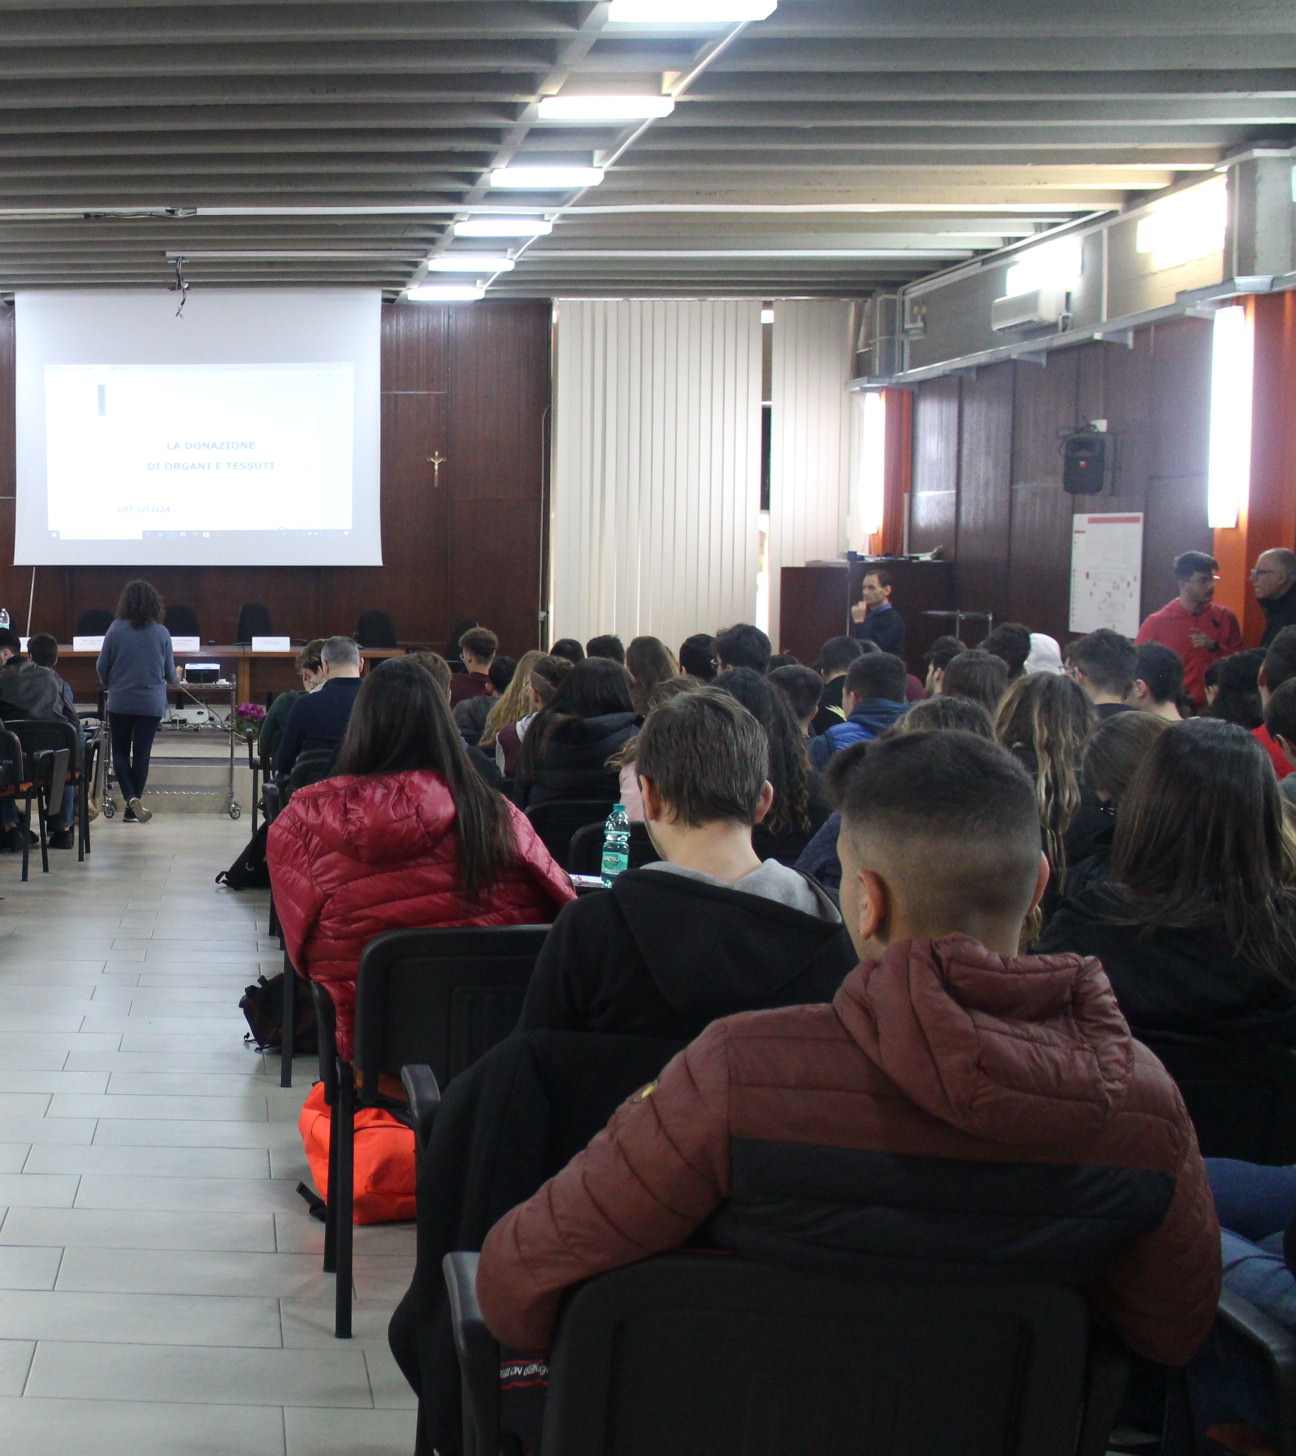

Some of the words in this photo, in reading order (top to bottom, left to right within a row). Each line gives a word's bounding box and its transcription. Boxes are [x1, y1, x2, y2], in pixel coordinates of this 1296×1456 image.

[166, 441, 181, 450] LA
[184, 441, 256, 450] DONAZIONE
[147, 462, 160, 471] DI
[164, 462, 211, 471] ORGANI
[215, 462, 223, 471] E
[225, 461, 275, 471] TESSUTI
